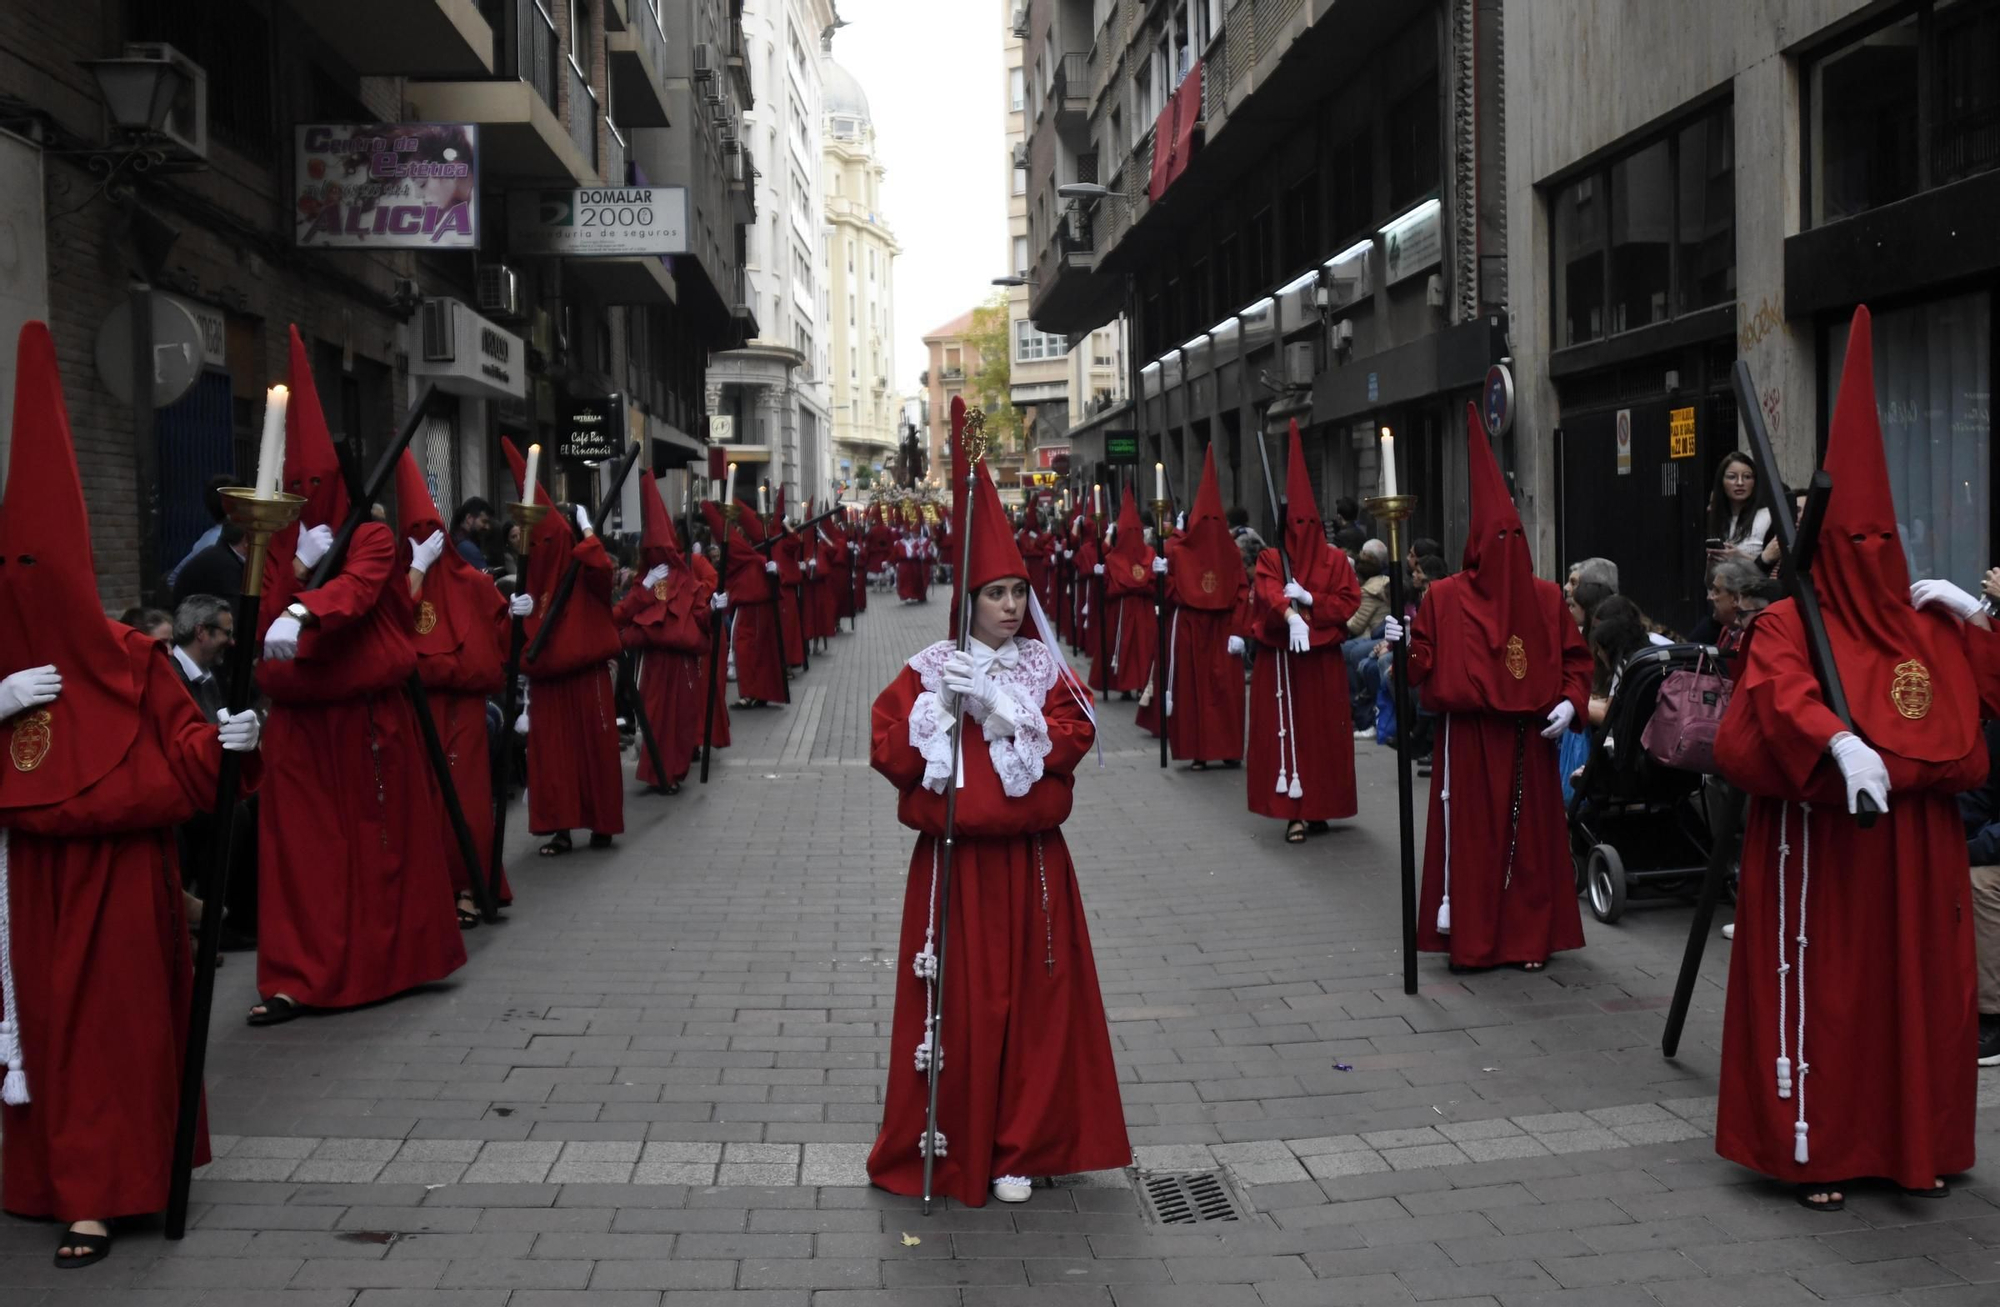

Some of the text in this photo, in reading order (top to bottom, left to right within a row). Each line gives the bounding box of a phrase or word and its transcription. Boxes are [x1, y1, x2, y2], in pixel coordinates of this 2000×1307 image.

[304, 127, 419, 153] Centro de
[580, 190, 652, 203] DOMALAR
[302, 201, 473, 243] ALICIA
[581, 207, 653, 226] 2000
[601, 229, 616, 239] de
[624, 229, 678, 241] seguros
[571, 431, 604, 446] Café Bar
[560, 444, 569, 455] El
